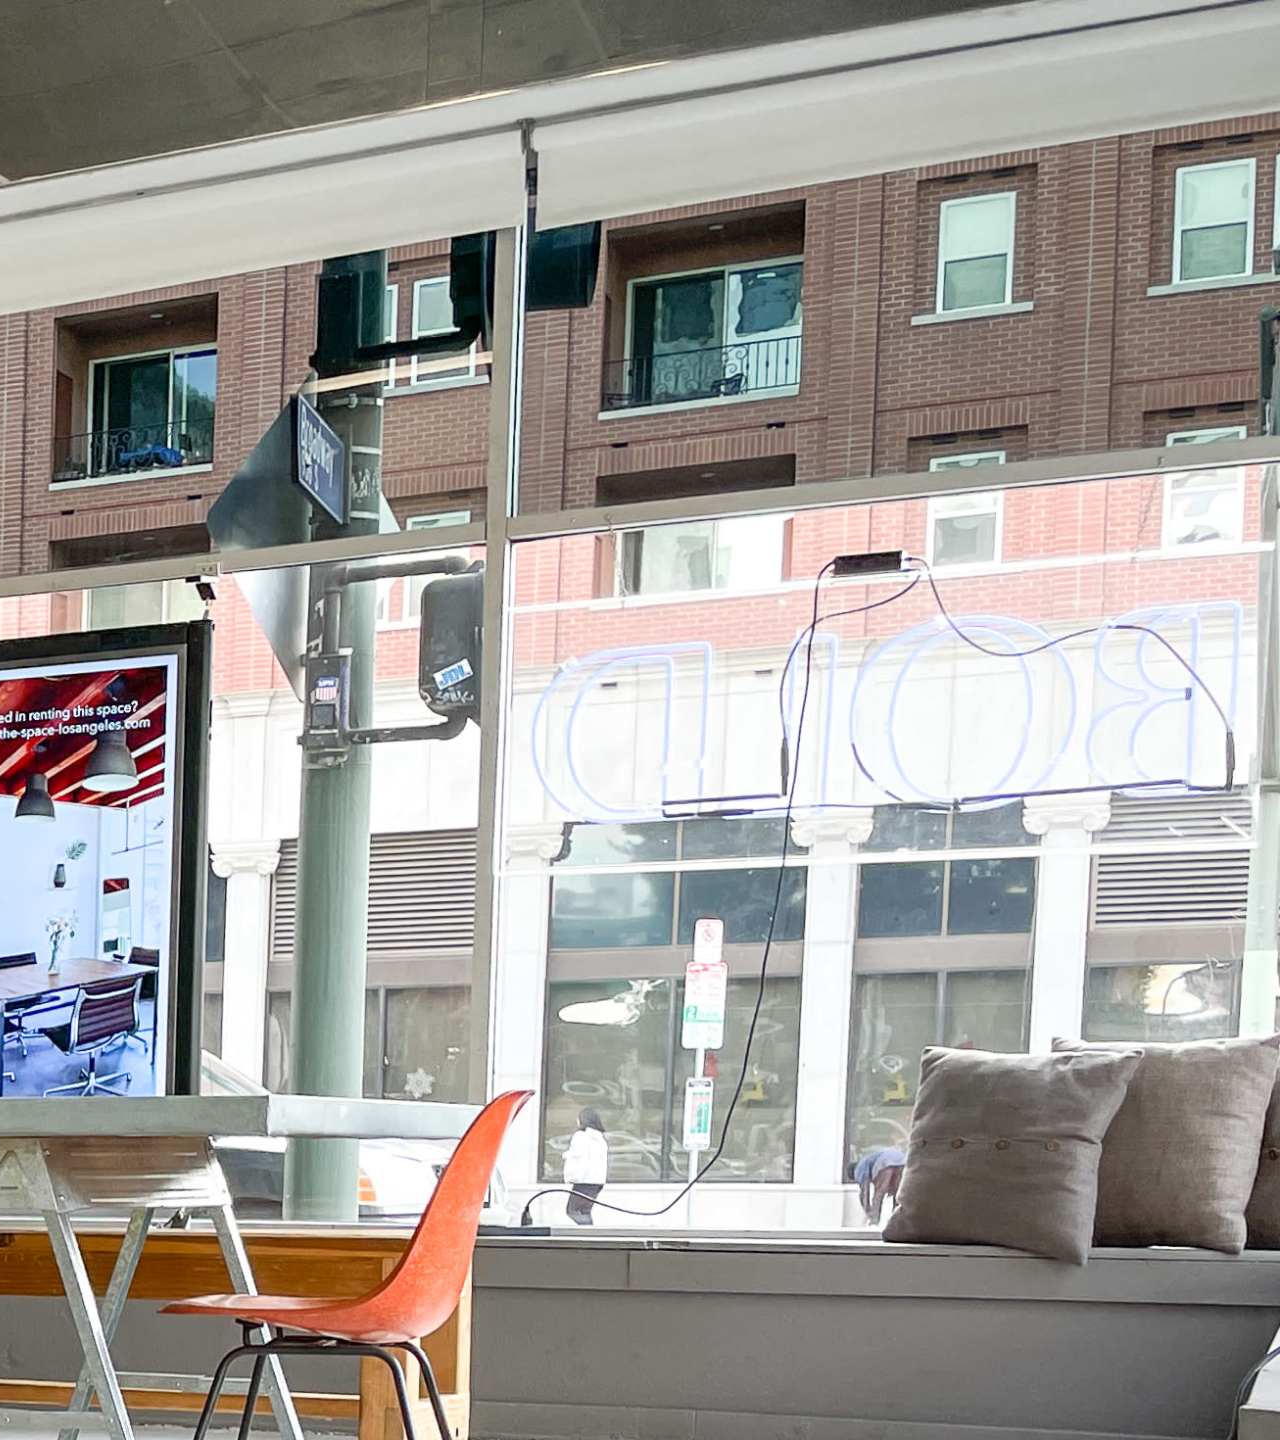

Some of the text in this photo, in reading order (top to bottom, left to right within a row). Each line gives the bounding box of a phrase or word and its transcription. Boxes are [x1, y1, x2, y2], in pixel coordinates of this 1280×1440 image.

[28, 707, 71, 723] renting
[73, 704, 95, 718] this
[96, 700, 138, 717] space?
